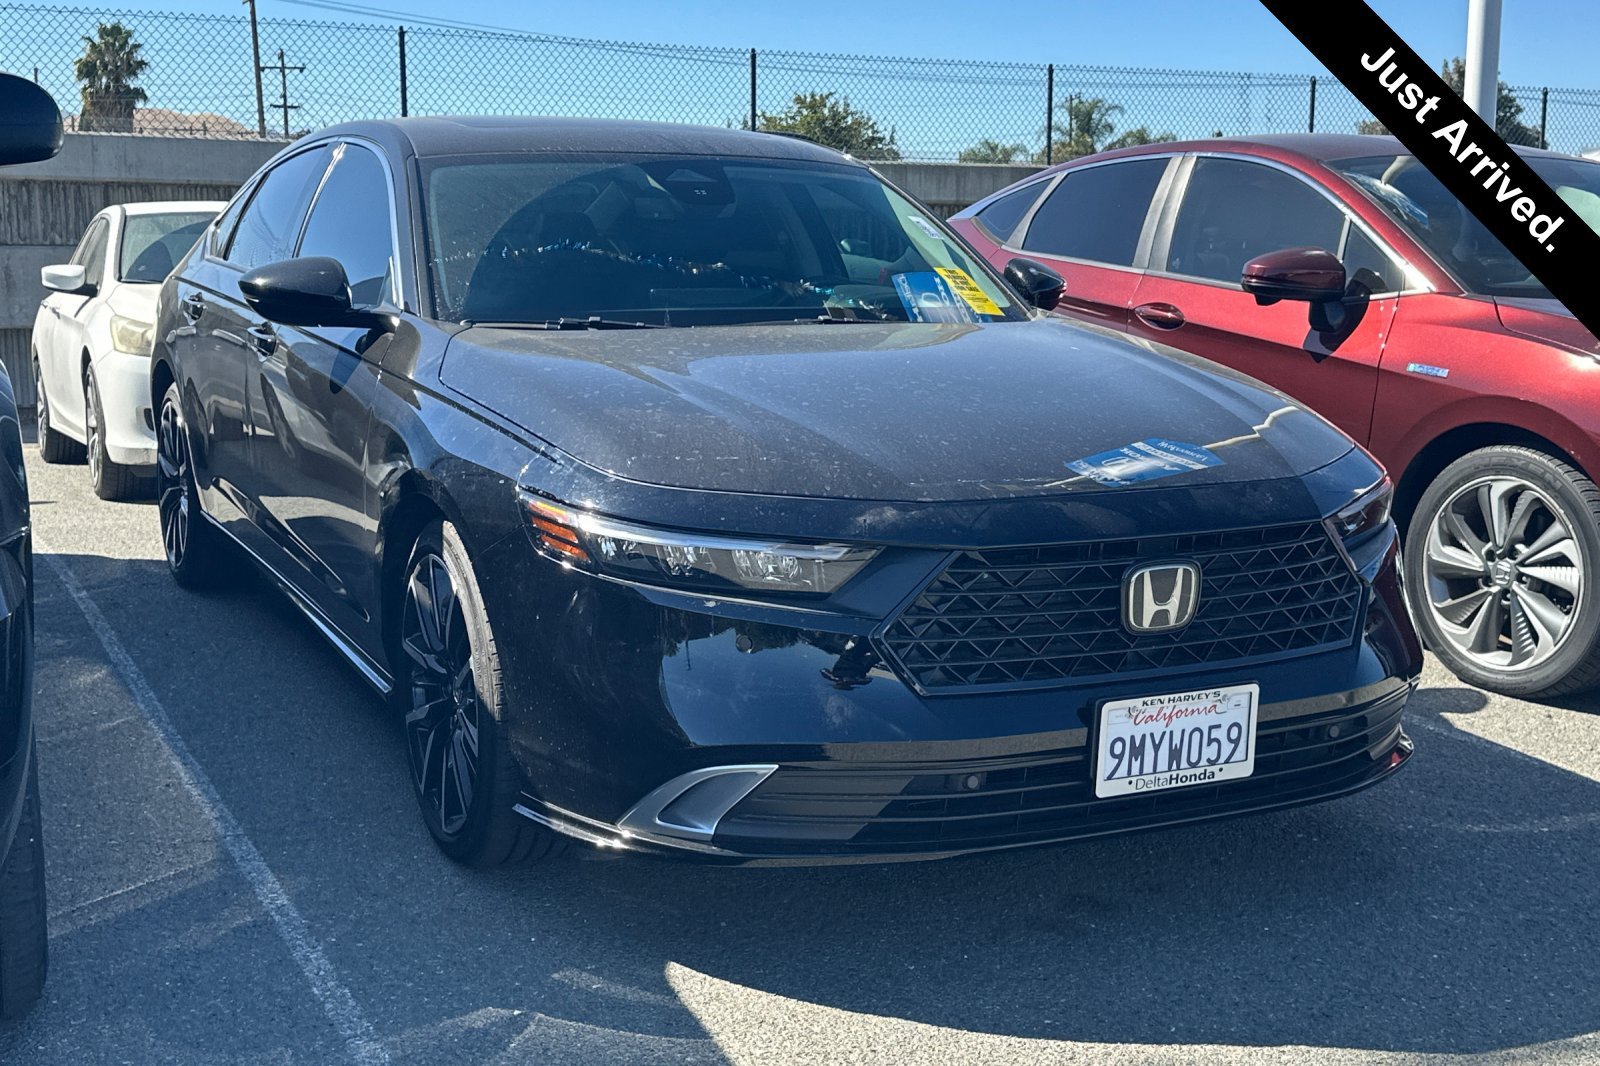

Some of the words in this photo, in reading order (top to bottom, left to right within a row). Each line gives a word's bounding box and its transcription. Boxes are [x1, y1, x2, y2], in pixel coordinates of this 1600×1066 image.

[1473, 456, 1563, 489] NEXEN
[1141, 698, 1165, 707] KEN
[1167, 690, 1221, 705] HARVEY'S
[1133, 703, 1226, 728] California
[1106, 721, 1243, 780] 9MYW059
